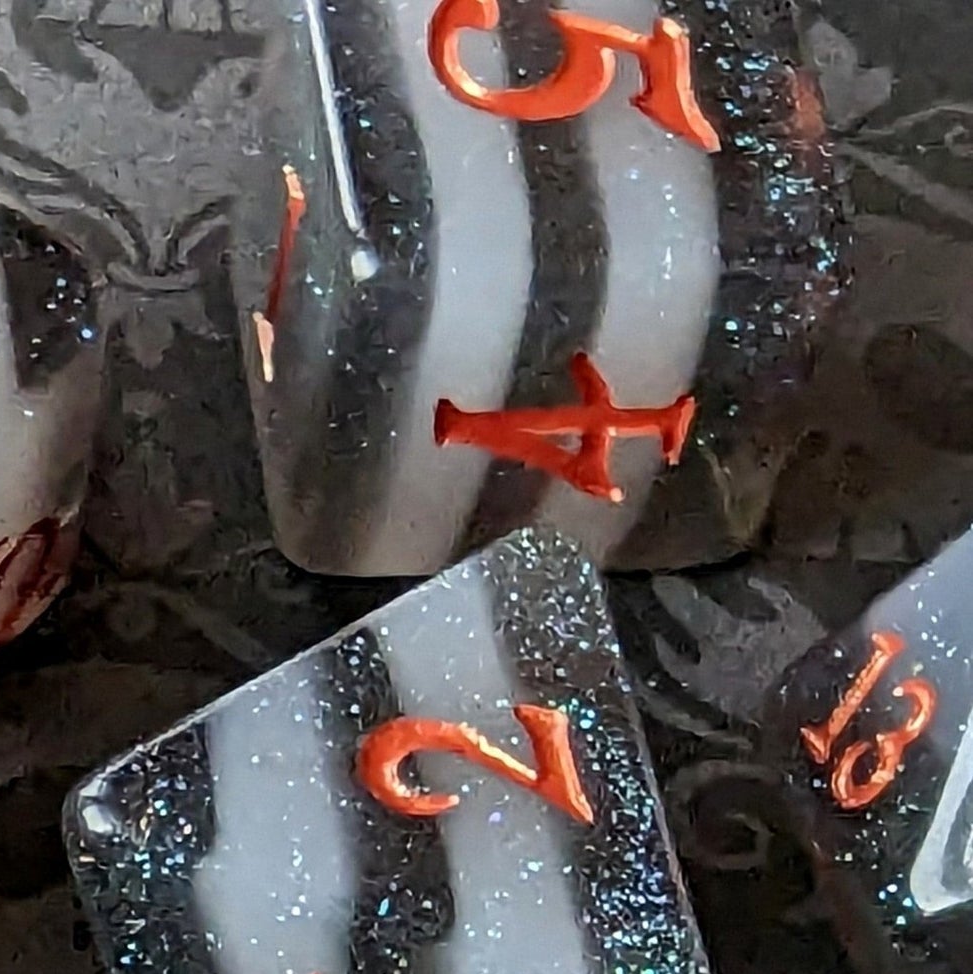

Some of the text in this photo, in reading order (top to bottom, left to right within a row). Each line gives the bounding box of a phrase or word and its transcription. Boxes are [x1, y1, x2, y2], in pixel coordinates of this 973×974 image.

[430, 0, 721, 153] 5
[434, 351, 697, 504] 4
[357, 703, 594, 825] 2
